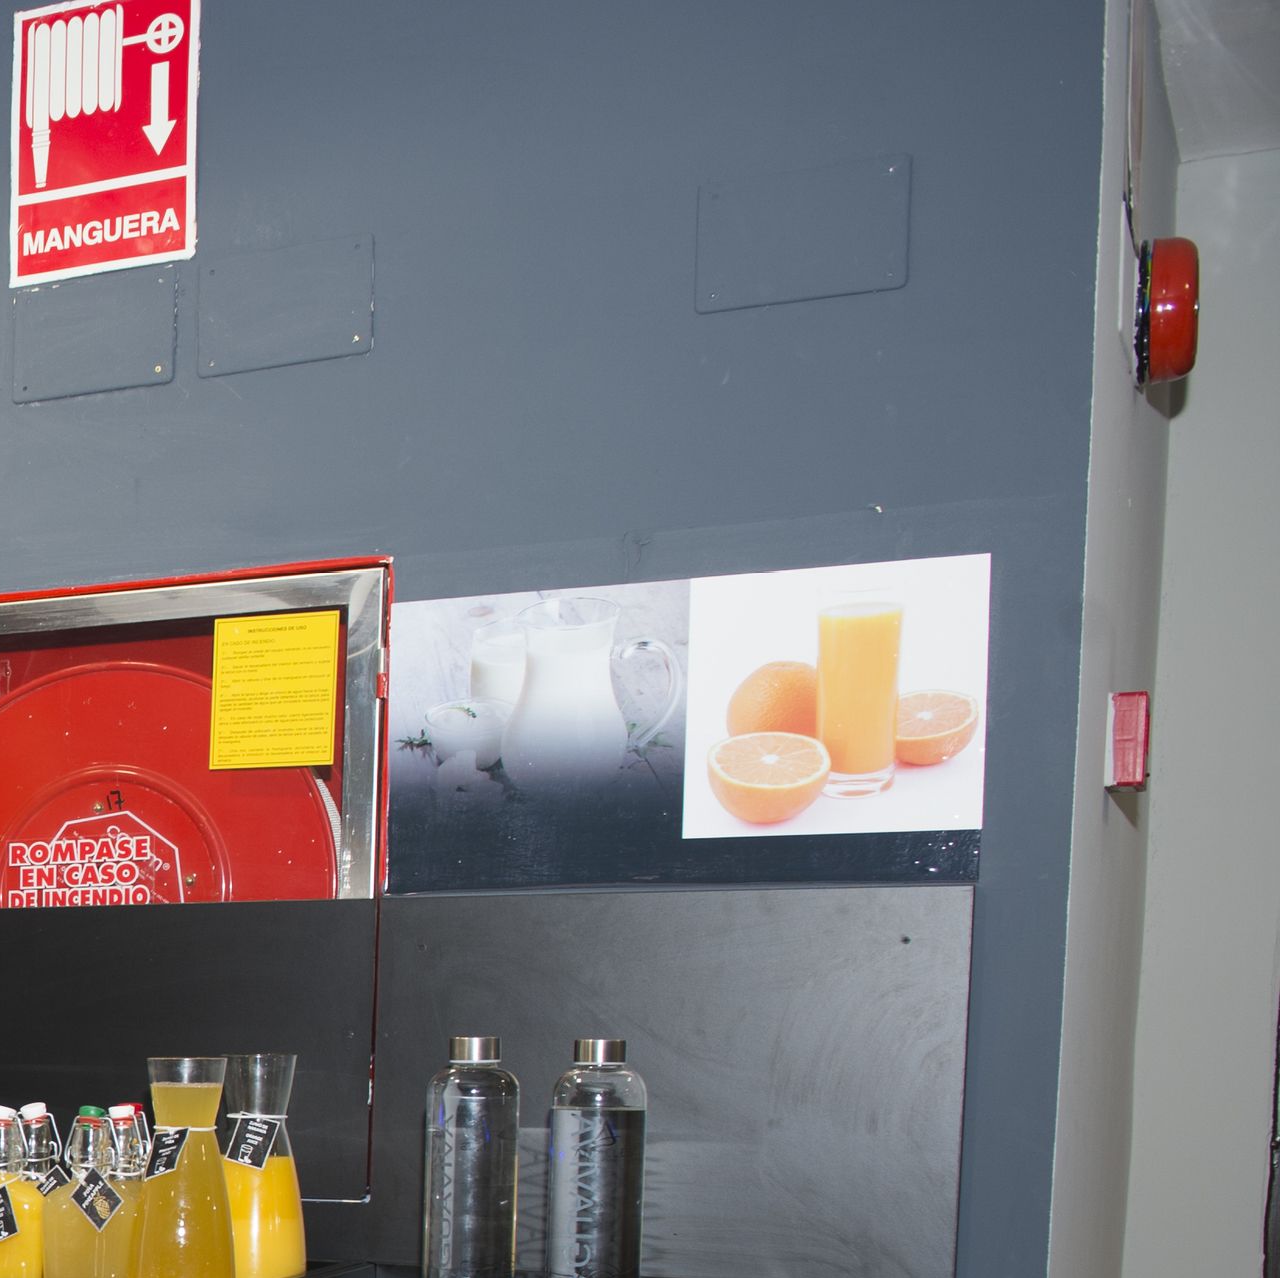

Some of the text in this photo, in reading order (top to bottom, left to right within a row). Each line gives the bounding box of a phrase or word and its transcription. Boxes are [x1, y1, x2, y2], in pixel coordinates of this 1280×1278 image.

[22, 207, 180, 257] MANGUERA
[106, 790, 125, 811] 17
[9, 836, 151, 867] ROMPASE
[20, 866, 57, 889] EN
[63, 861, 140, 888] CASO
[8, 889, 37, 909] DE
[42, 884, 150, 908] INCENDIO
